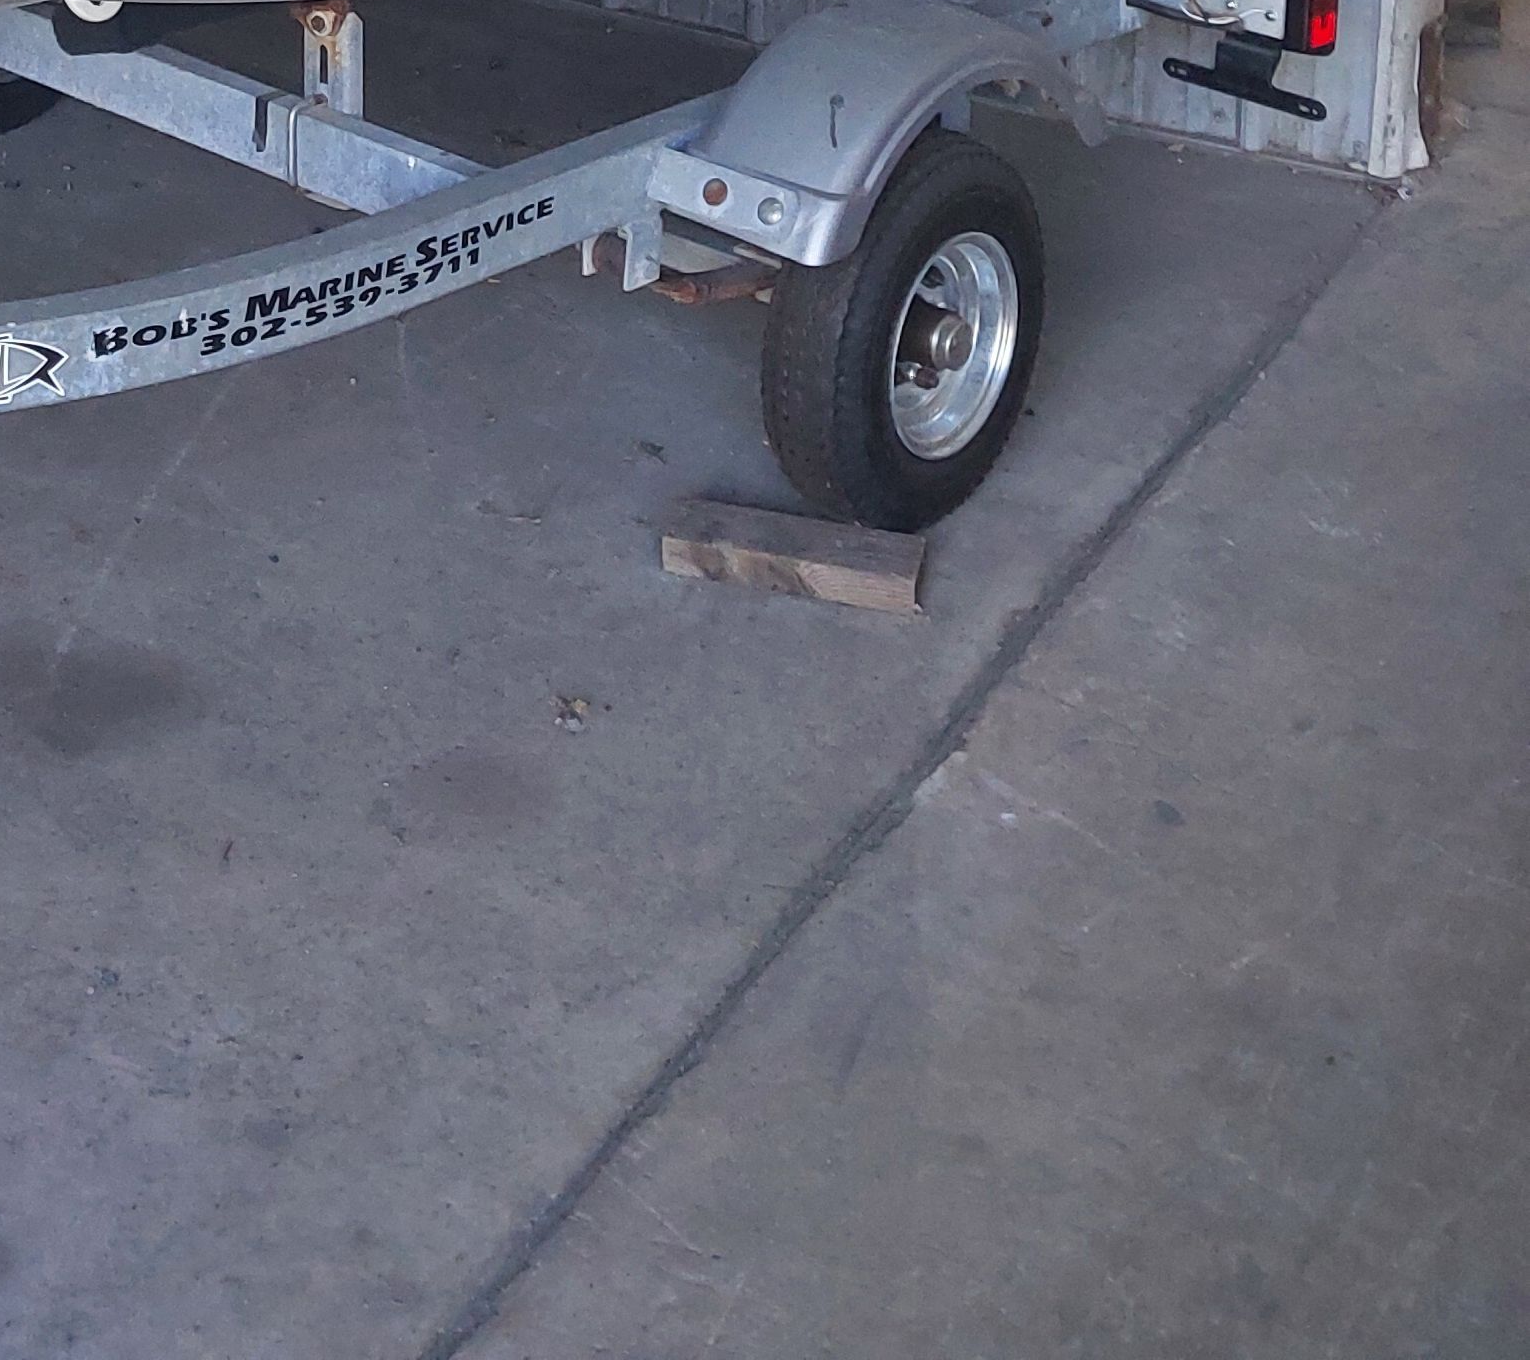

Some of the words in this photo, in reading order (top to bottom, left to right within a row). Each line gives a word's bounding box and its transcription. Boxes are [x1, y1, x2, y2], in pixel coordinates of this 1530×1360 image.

[93, 308, 231, 359] BOB'S
[245, 254, 407, 323] MARINE
[415, 196, 555, 267] SERVICE
[200, 247, 481, 357] 302-539-3711
